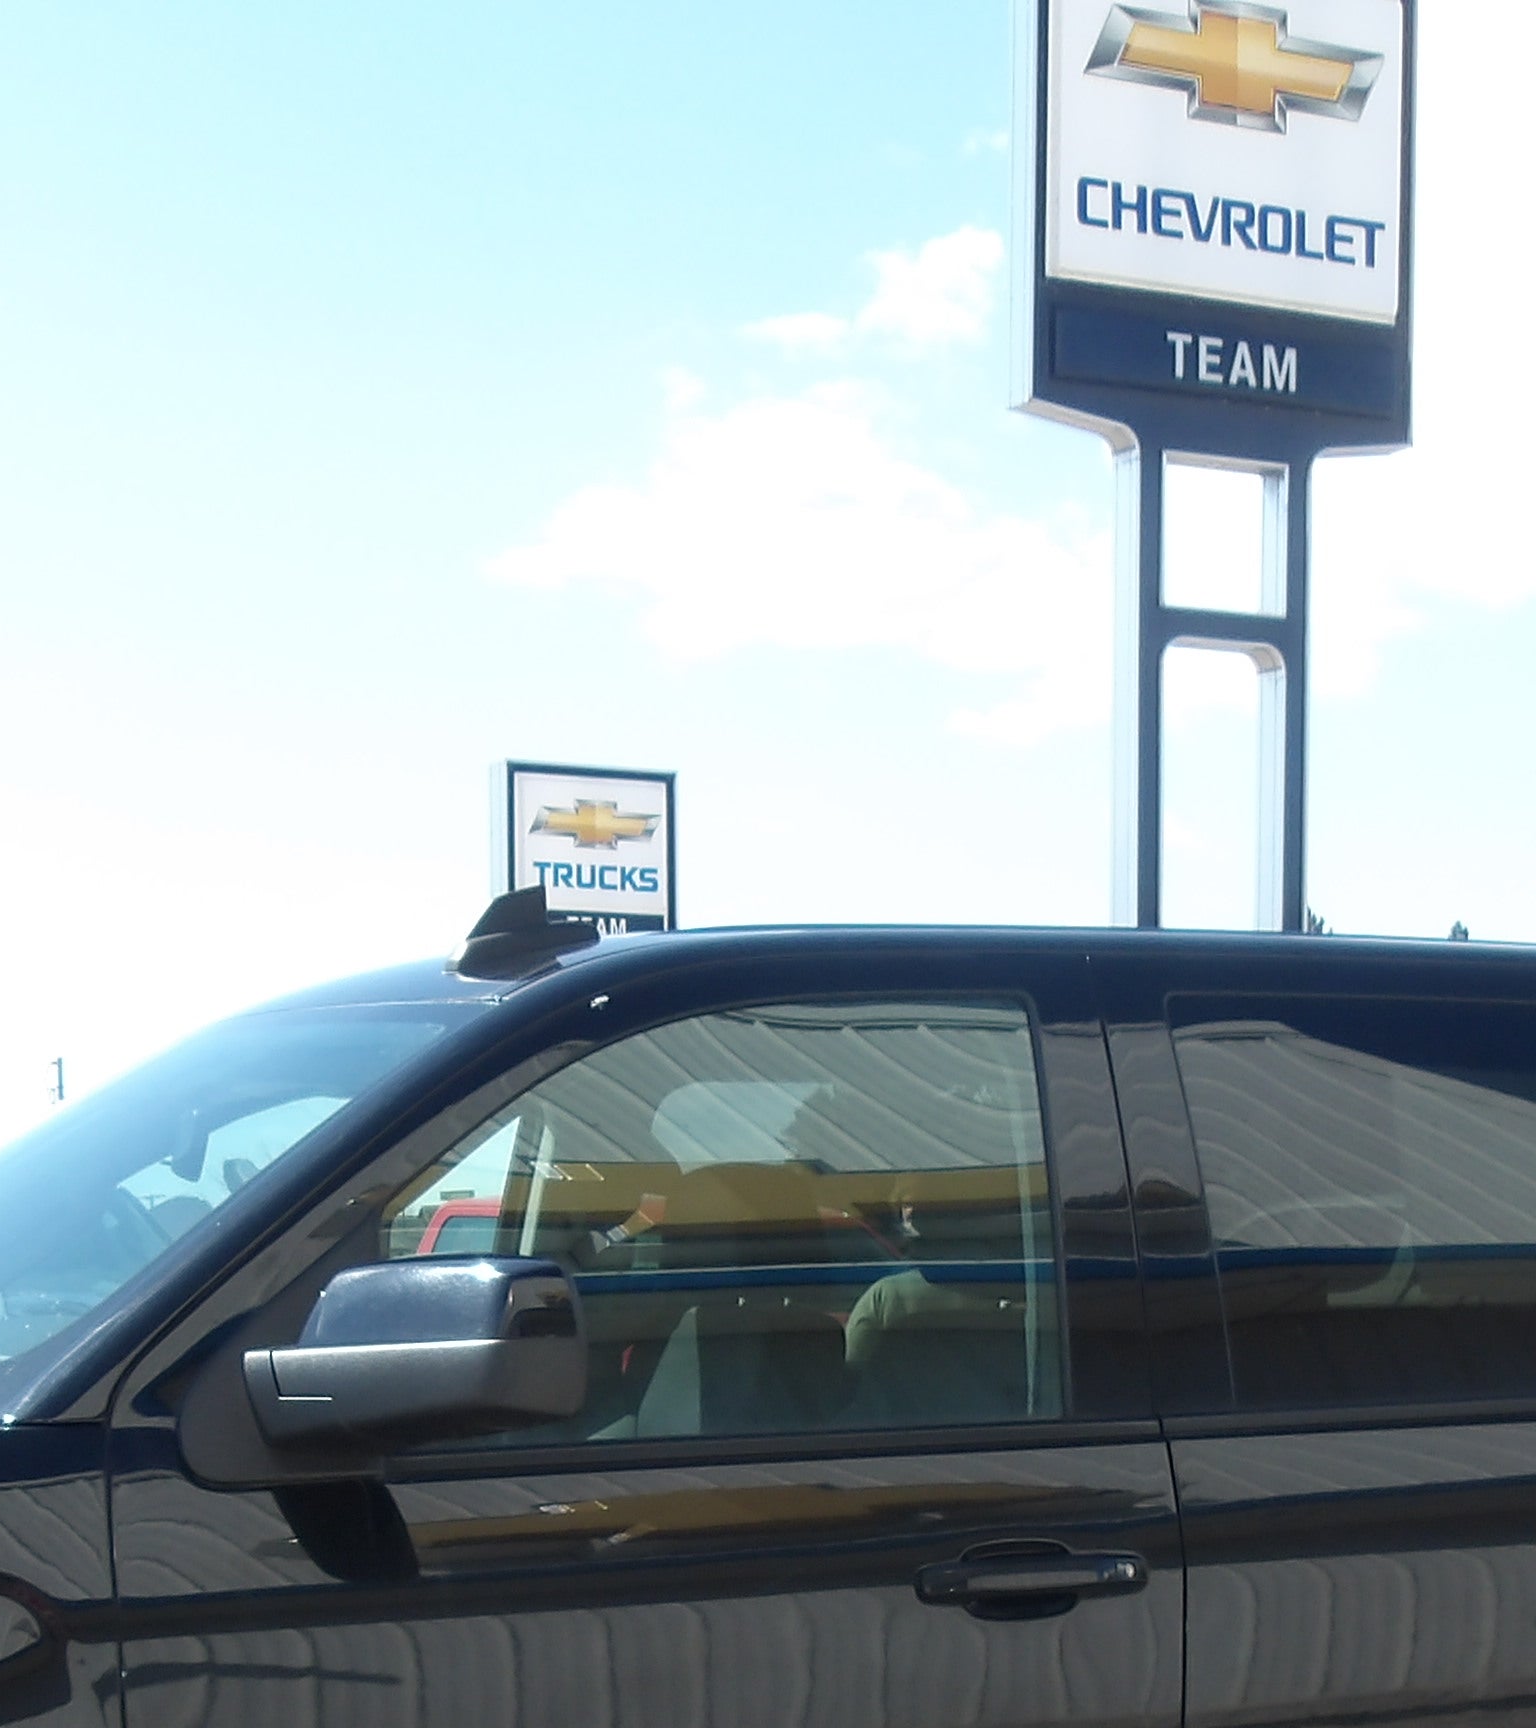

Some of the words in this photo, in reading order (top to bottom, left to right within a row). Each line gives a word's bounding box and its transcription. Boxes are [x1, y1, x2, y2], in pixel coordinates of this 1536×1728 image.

[1076, 175, 1386, 269] CHEVROLET
[1165, 330, 1298, 393] TEAM
[532, 860, 659, 893] TRUCKS
[567, 915, 627, 935] AM
